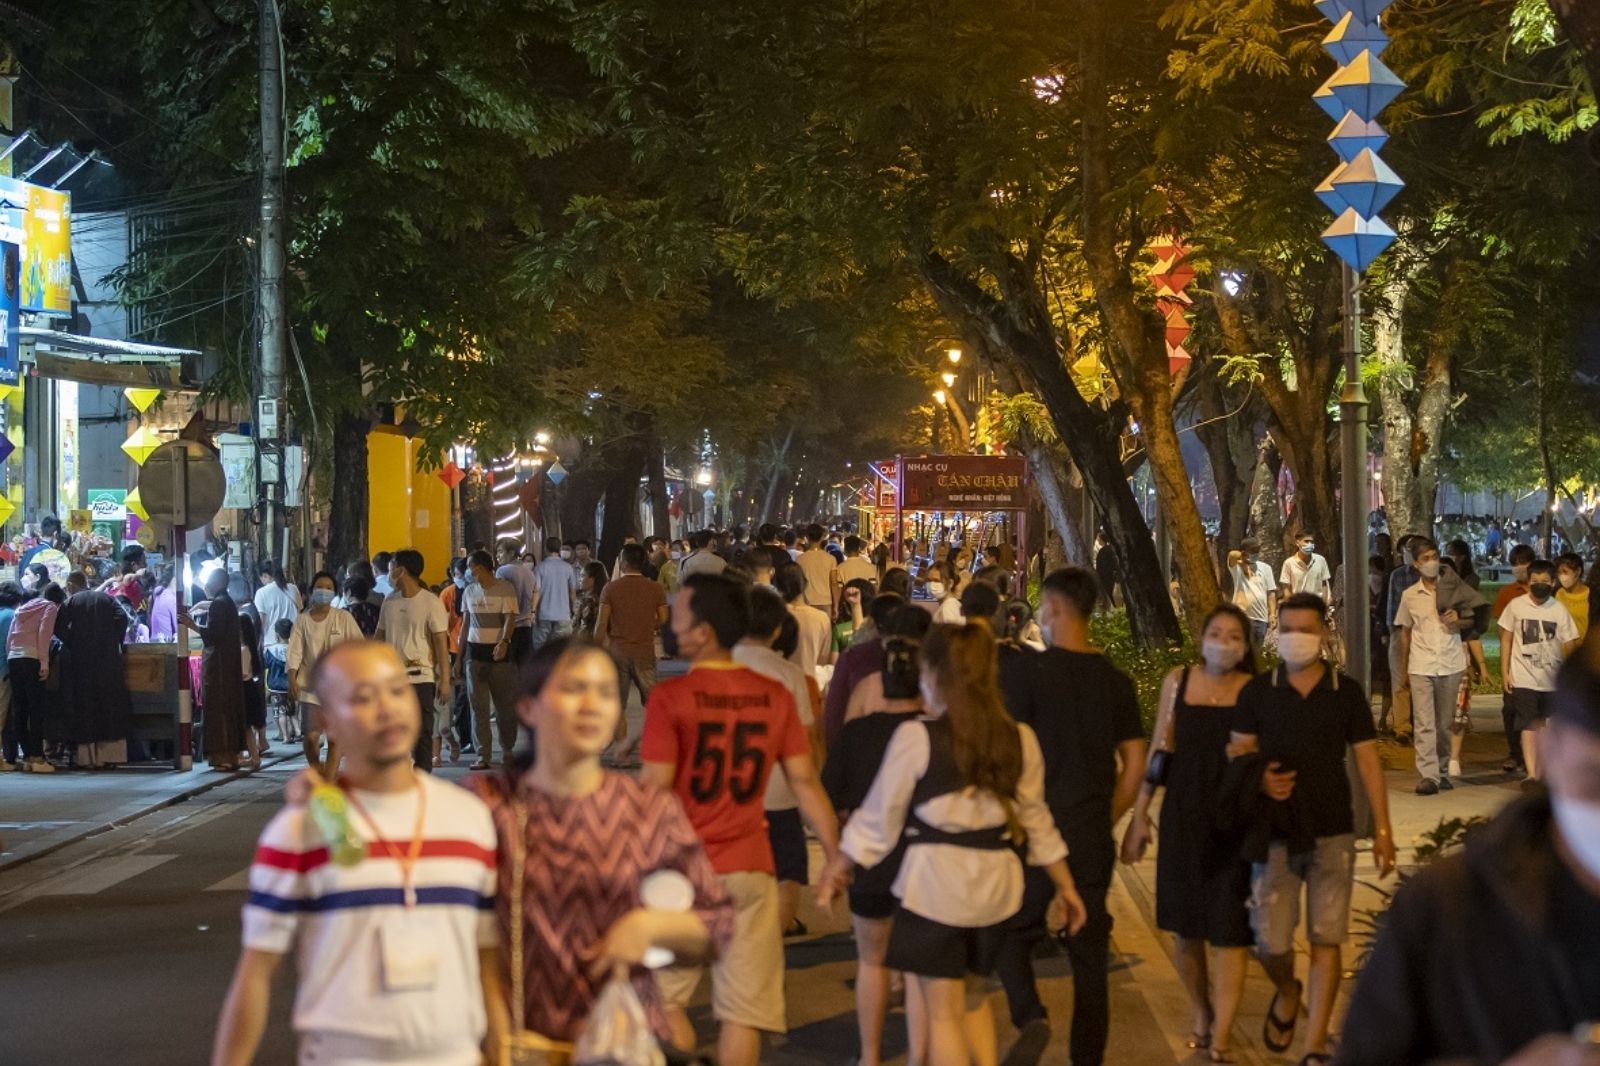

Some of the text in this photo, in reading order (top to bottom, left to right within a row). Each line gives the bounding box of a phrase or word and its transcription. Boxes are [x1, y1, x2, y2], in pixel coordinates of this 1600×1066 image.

[907, 463, 948, 472] NHẠC CỤ
[690, 721, 768, 805] 55
